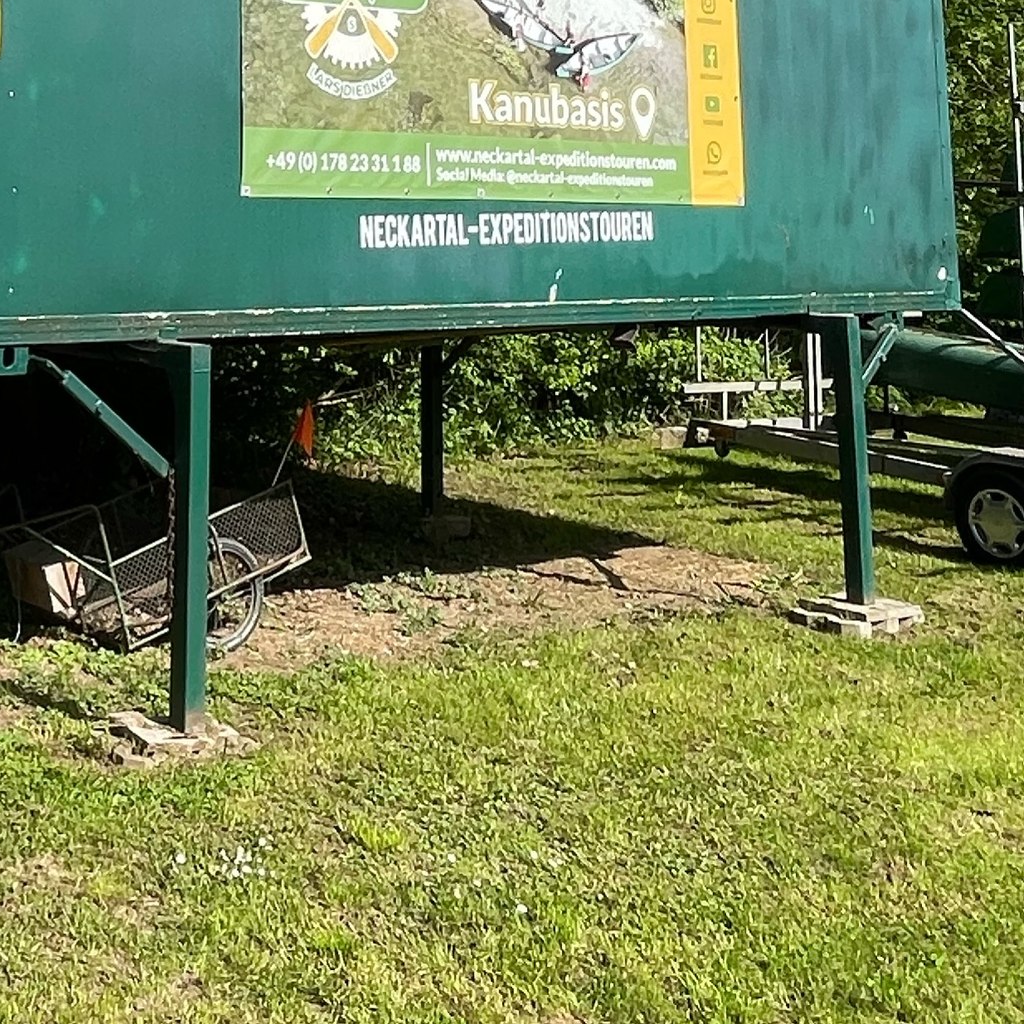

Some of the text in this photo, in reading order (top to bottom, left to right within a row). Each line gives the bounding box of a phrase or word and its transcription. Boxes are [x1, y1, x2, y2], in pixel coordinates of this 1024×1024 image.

[308, 65, 341, 94] LARS
[469, 79, 625, 130] Kanubasis
[266, 151, 296, 171] +49
[298, 151, 317, 174] (0)
[320, 152, 348, 172] 178
[349, 153, 370, 173] 23
[371, 153, 390, 173] 31
[435, 147, 677, 172] www.neckartal-expeditionstouren.com
[436, 167, 654, 188] Social Media: @neckartal-expeditionstouren
[359, 210, 654, 248] NECKARTAL-EXPEDITIONSTOUREN
